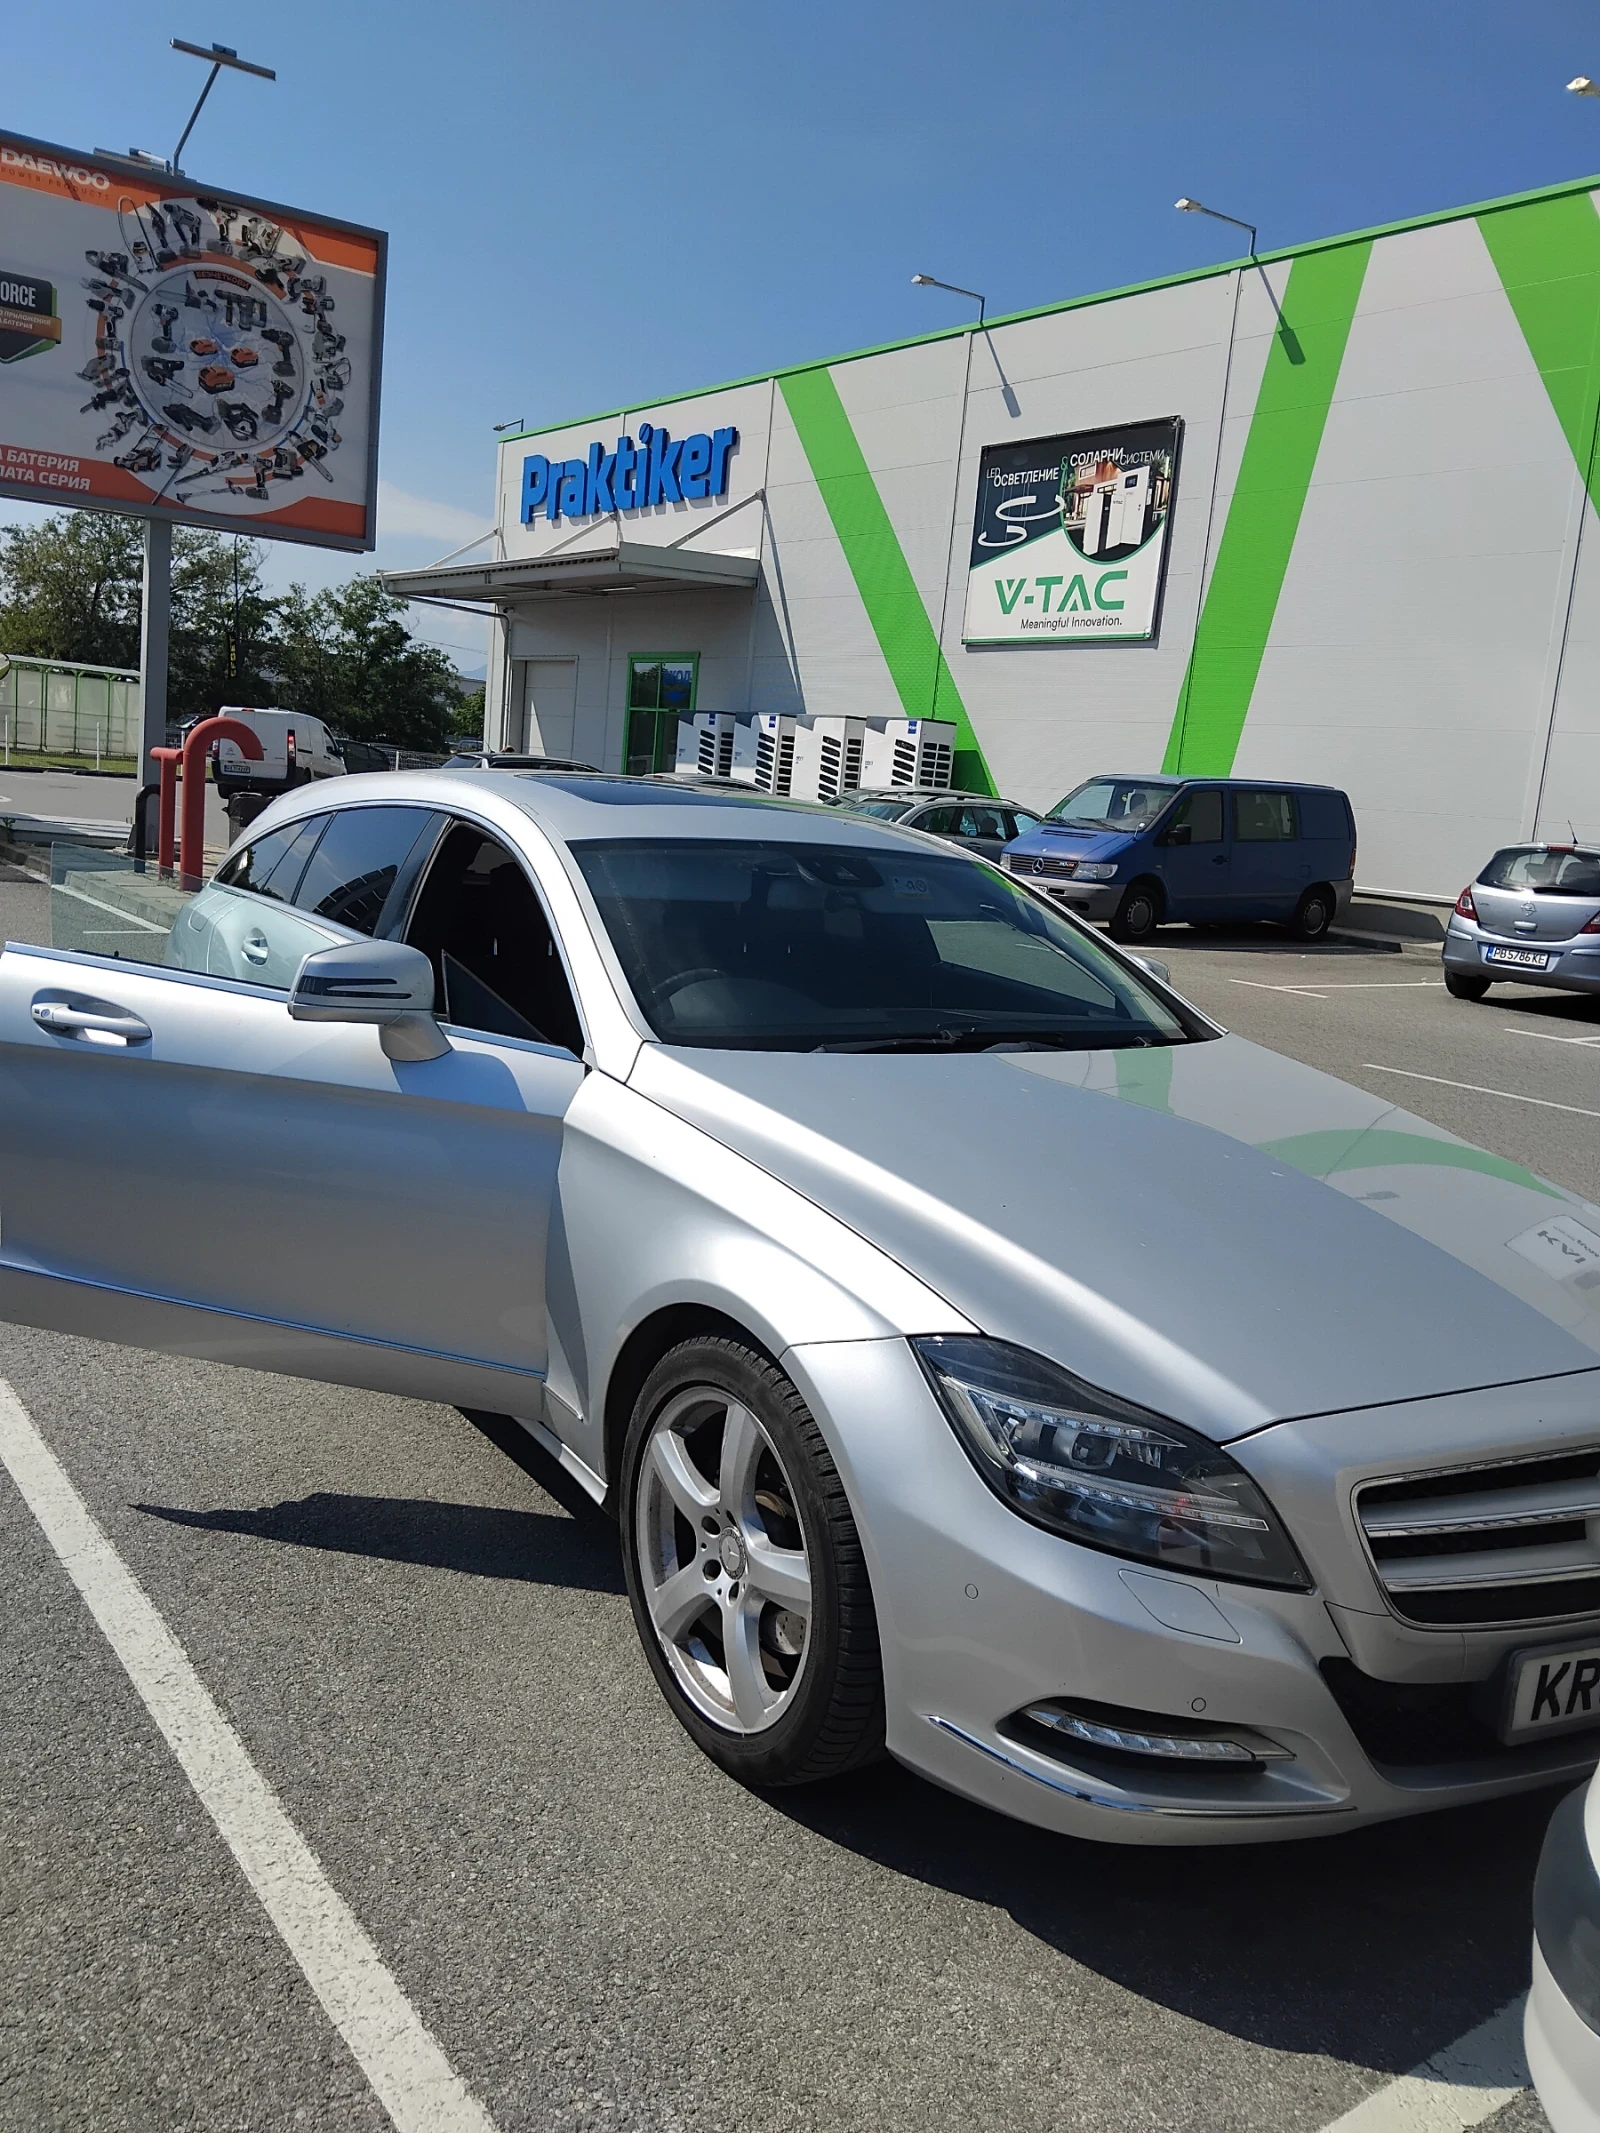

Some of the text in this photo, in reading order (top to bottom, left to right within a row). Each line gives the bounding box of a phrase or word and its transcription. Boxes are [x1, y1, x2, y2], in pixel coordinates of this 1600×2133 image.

[1, 147, 110, 190] DAEWOO
[1, 166, 109, 201] POWER PRODUCTS
[196, 271, 249, 289] БЕЗЧЕТКОВИ
[3, 318, 33, 330] БАТЕРИЯ
[7, 449, 80, 473] БАТЕРИЯ
[1070, 447, 1124, 467] СОЛАРНИ
[1120, 449, 1165, 466] СИСТЕМИ
[38, 471, 91, 491] СЕРИЯ
[520, 422, 738, 524] Praktiker
[986, 467, 1001, 479] LED
[993, 467, 1059, 487] ОСВЕТЛЕНИЕ
[994, 570, 1129, 615] V-TAC
[1020, 615, 1123, 631] Meaningful Innovation.
